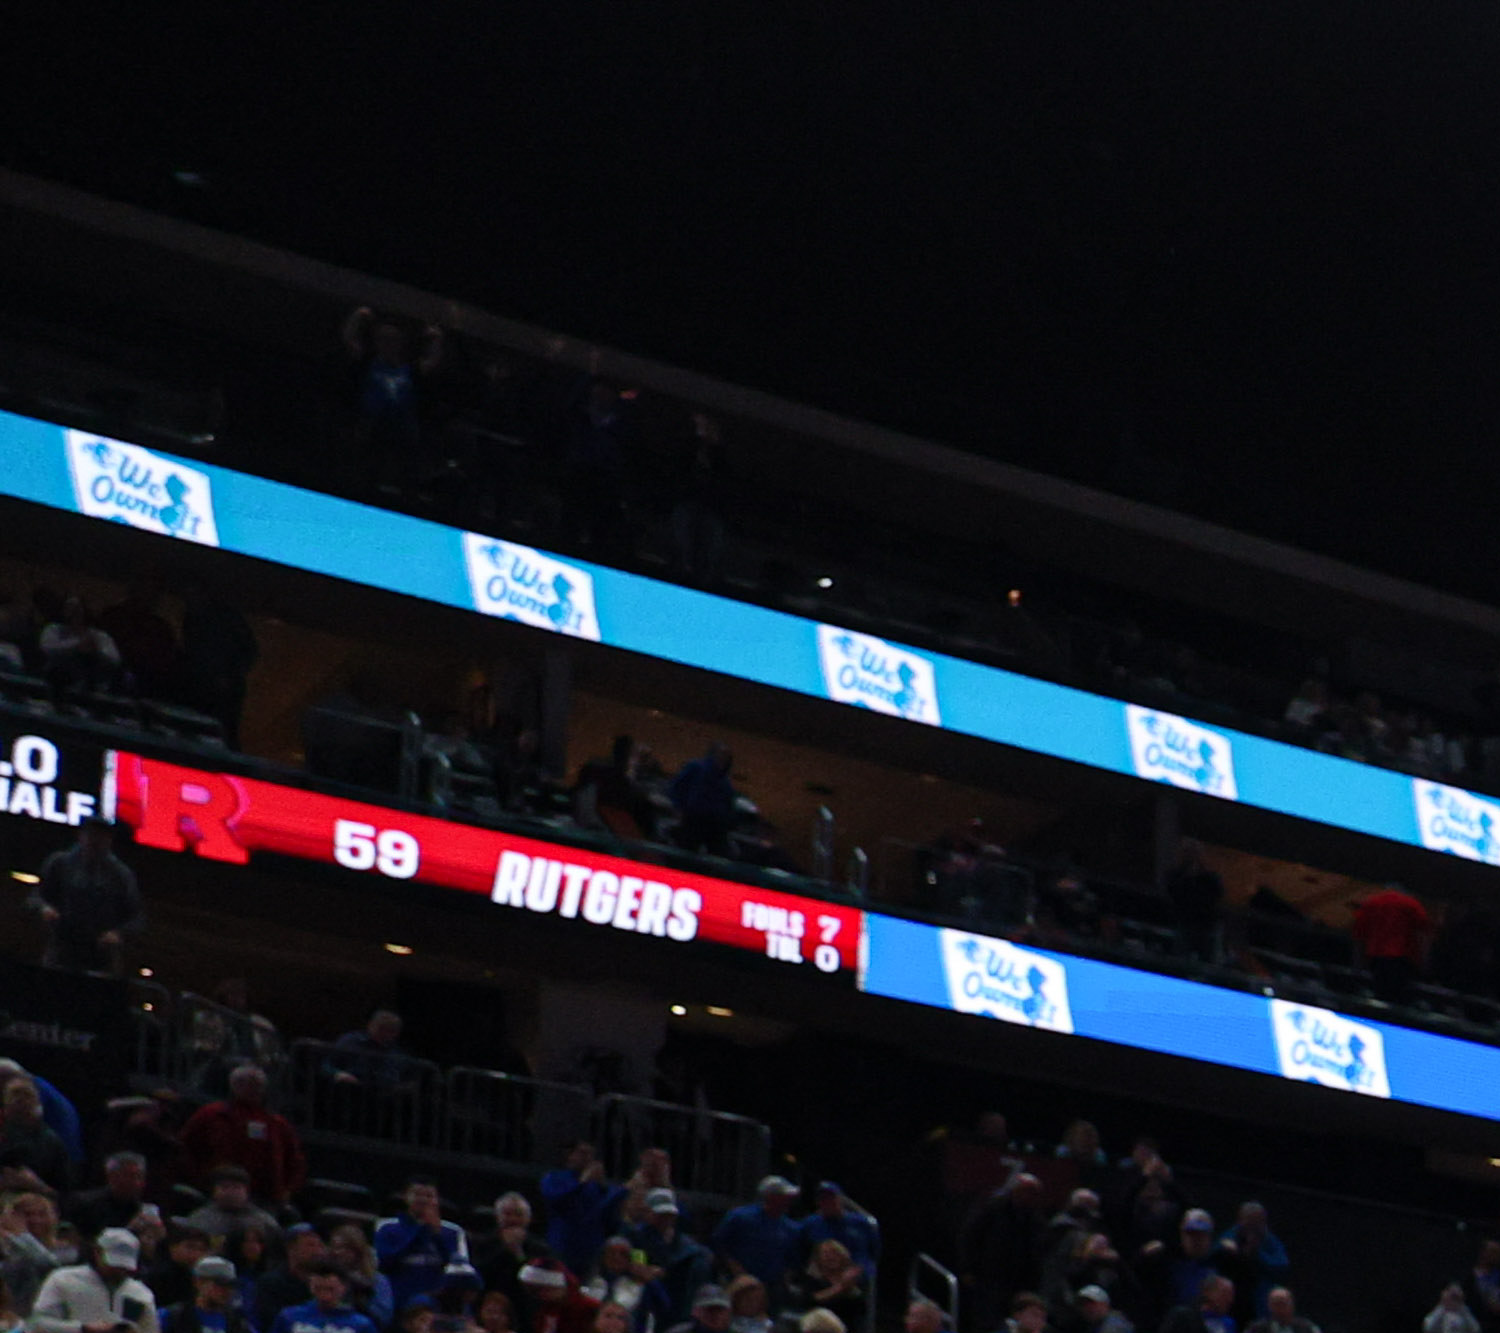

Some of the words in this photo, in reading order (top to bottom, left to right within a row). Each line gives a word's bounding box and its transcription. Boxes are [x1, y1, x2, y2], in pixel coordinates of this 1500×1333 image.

[91, 474, 161, 519] Own
[118, 454, 162, 498] We
[486, 574, 549, 616] Own
[510, 555, 550, 596] We
[838, 663, 894, 702] Own
[860, 645, 895, 684] We
[335, 818, 419, 879] 59
[492, 850, 702, 941] RUTGERS
[741, 901, 804, 938] FOULS
[818, 915, 841, 942] 7
[815, 945, 840, 973] 0
[986, 949, 1024, 990] We
[963, 970, 1023, 1010] Own
[1291, 1038, 1345, 1076] Own
[1312, 1018, 1345, 1057] We
